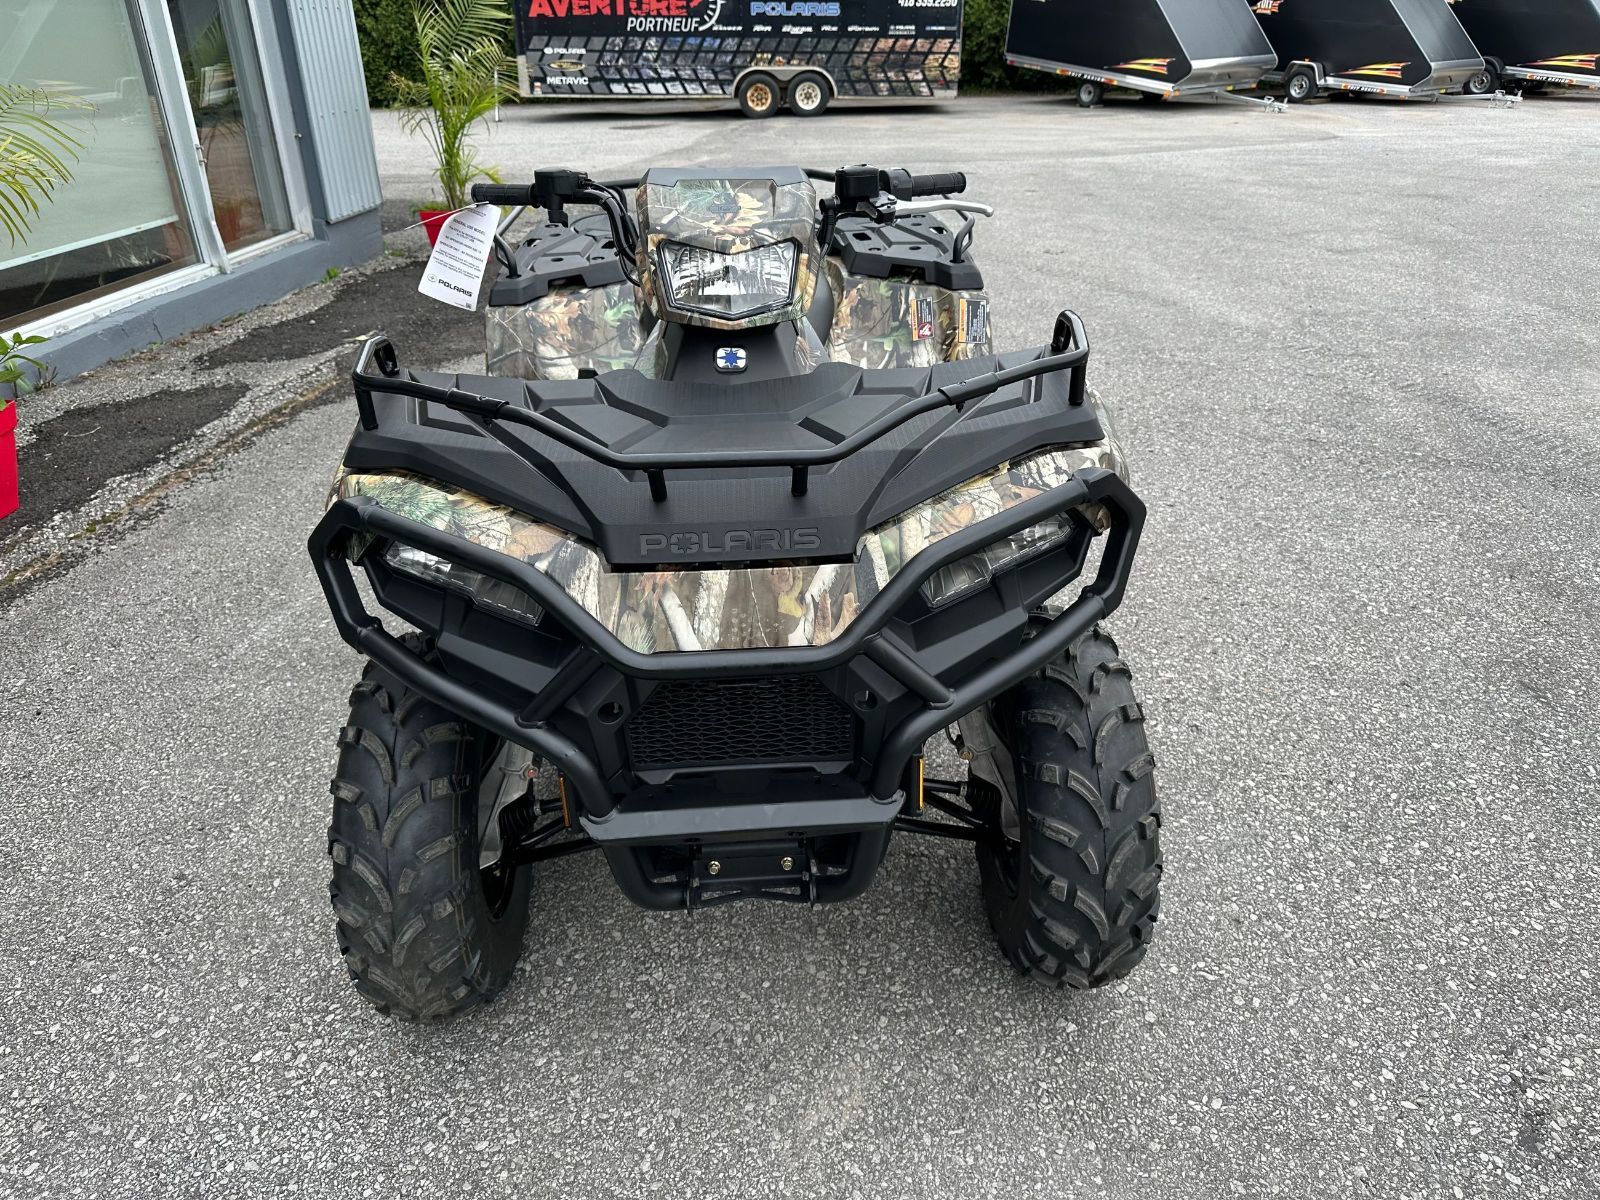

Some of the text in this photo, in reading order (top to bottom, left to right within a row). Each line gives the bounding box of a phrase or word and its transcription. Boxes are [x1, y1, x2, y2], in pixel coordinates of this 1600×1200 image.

[750, 1, 841, 16] POLARIS
[627, 17, 700, 32] PORTNEUF
[546, 76, 589, 85] METAVIC
[438, 278, 473, 297] POLARIS
[639, 527, 822, 556] POLARIS
